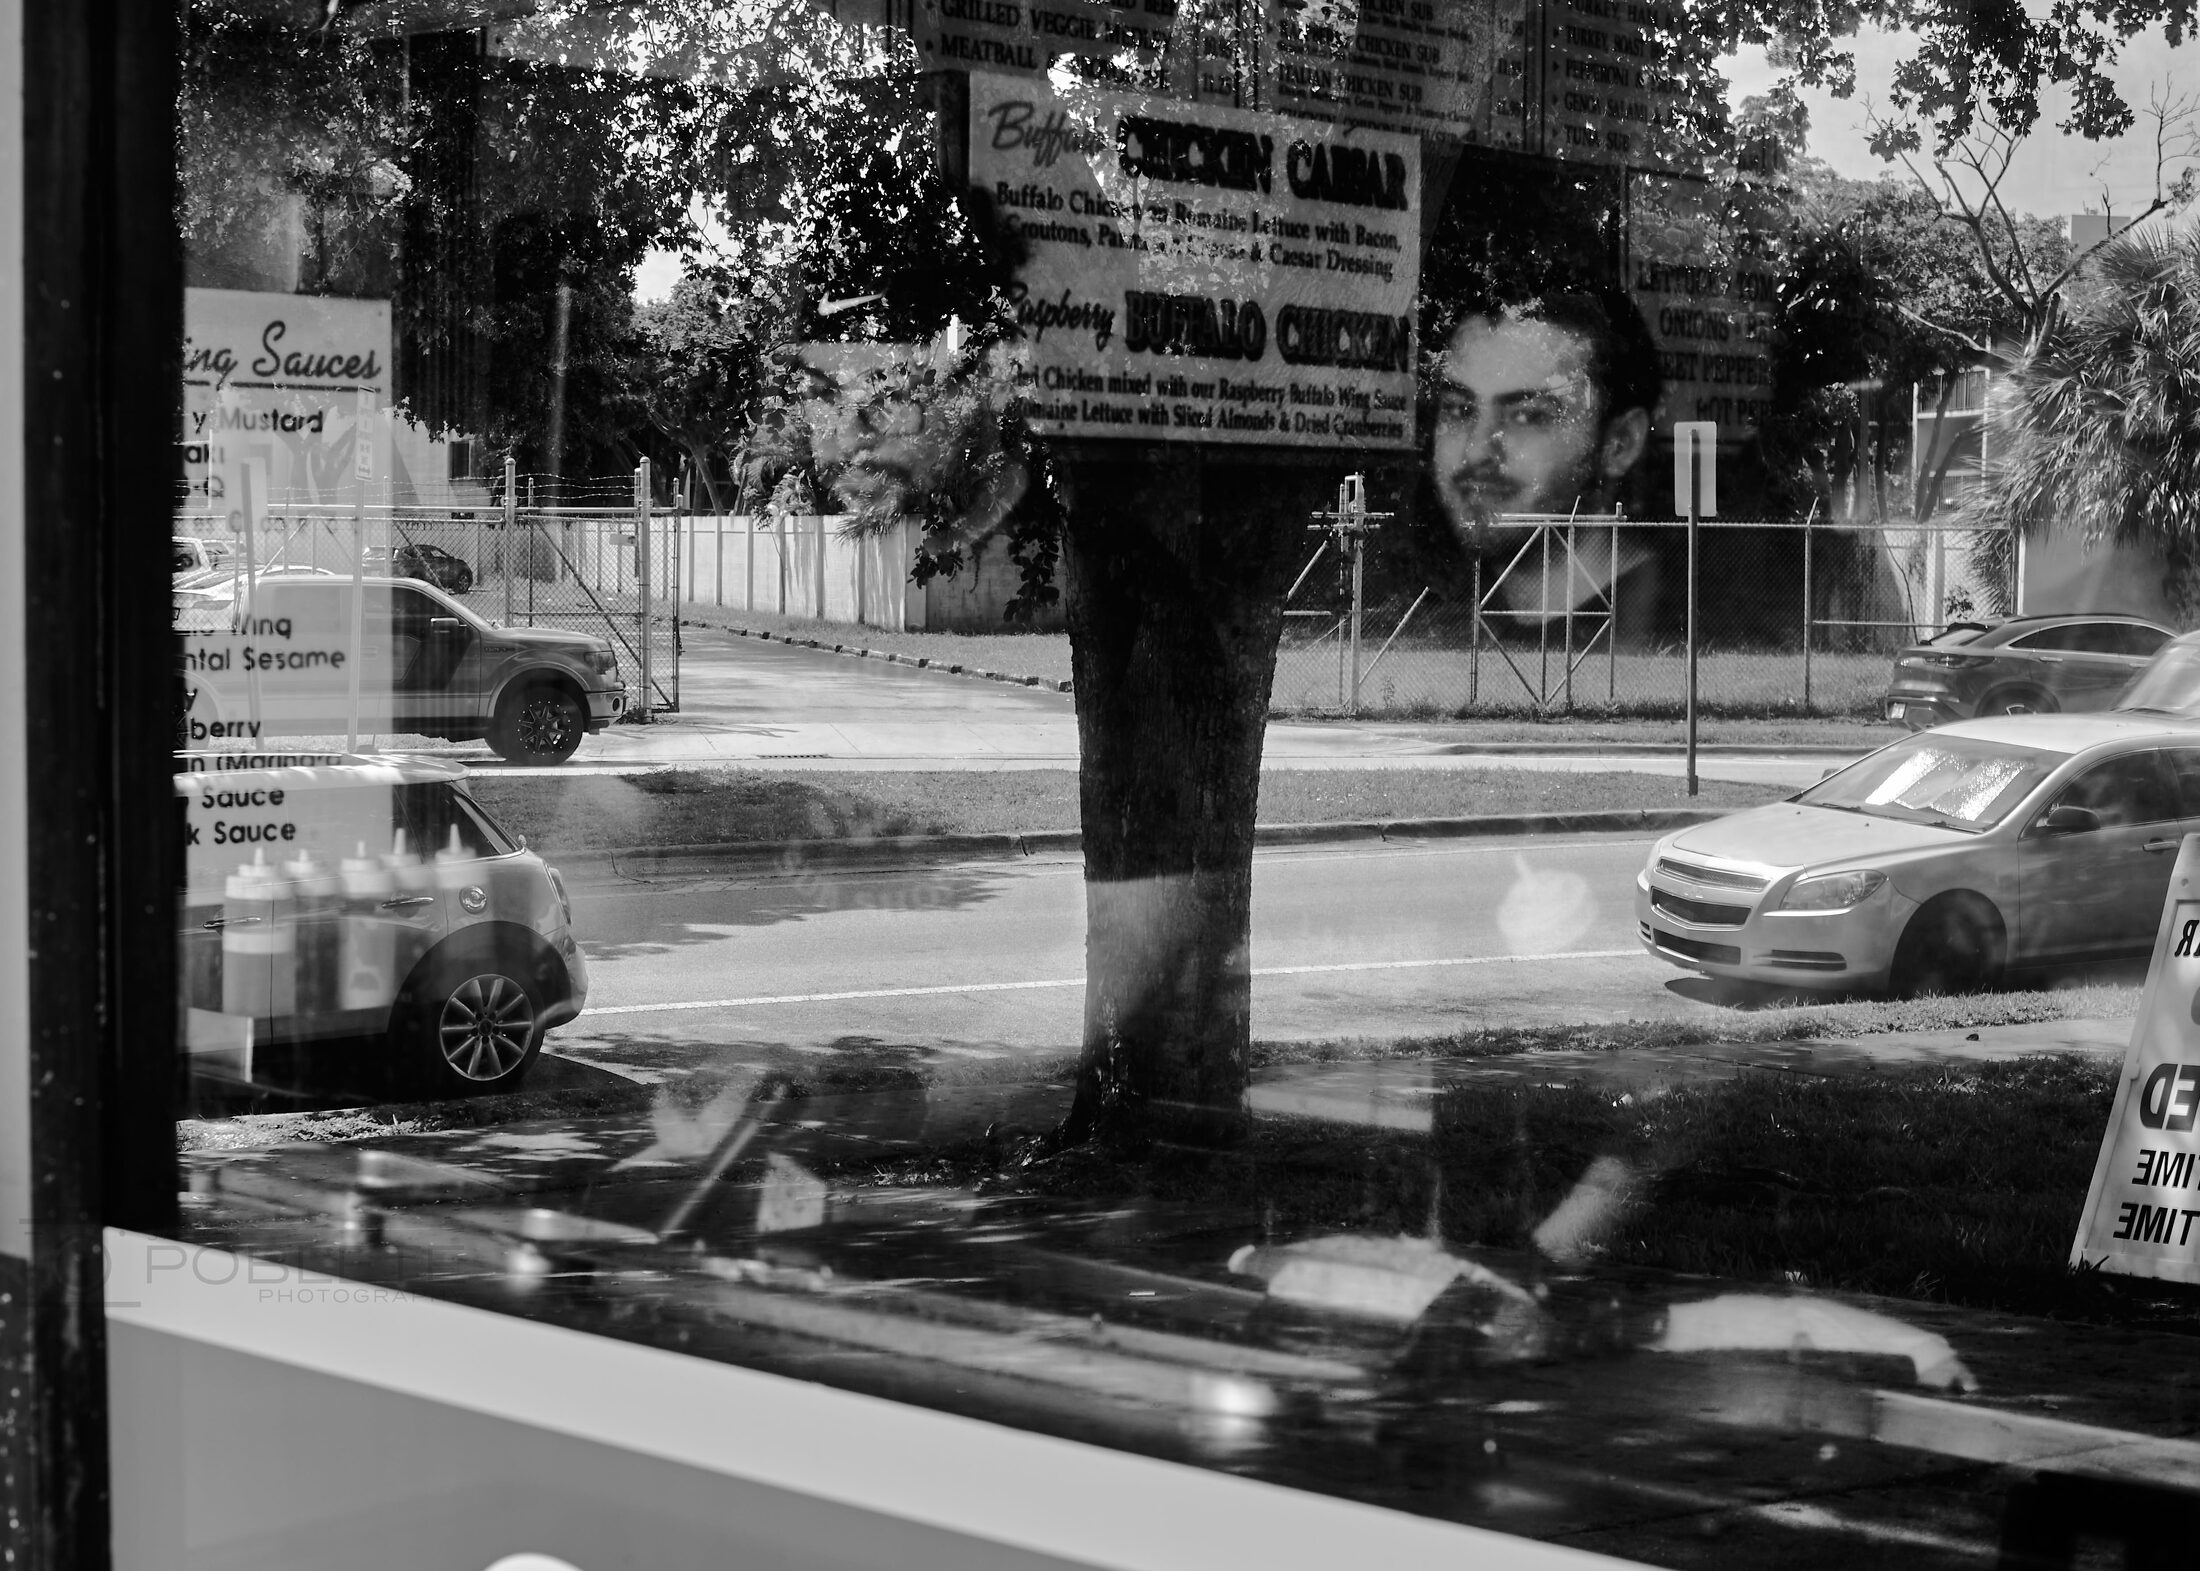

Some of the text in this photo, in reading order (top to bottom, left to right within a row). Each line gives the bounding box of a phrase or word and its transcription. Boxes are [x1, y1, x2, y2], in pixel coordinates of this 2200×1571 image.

[940, 0, 1020, 27] GRILLED
[1029, 8, 1096, 40] VEGGIE
[941, 33, 1037, 69] MEATBALL
[1356, 34, 1410, 60] CHICKEN
[1417, 45, 1440, 64] SUB
[1399, 83, 1422, 103] SUB
[988, 100, 1104, 167] Buffa
[1117, 114, 1273, 194] CHICKEN
[996, 181, 1064, 211] Buffalo
[1069, 190, 1142, 220] Chicn
[1252, 210, 1310, 239] Lettuce
[1315, 221, 1350, 245] with
[1355, 224, 1402, 253] Bacon,
[1270, 243, 1322, 269] Caesar
[1327, 248, 1393, 283] Dressing
[1124, 290, 1267, 362] BUFFALO
[1276, 304, 1411, 373] CHICKEN
[1659, 307, 1730, 341] ONIONS
[253, 320, 381, 380] Sauces
[1043, 365, 1104, 392] Chicken
[1108, 371, 1151, 395] mixed
[1156, 374, 1188, 398] with
[1191, 382, 1216, 399] our
[1219, 377, 1285, 409] Raspberry
[1290, 383, 1335, 406] Buffalo
[219, 406, 323, 432] Mustard
[1082, 398, 1134, 424] Lettuce
[1138, 402, 1170, 426] with
[1173, 404, 1212, 428] Sliced
[1217, 407, 1276, 431] Almonds
[243, 646, 345, 671] Sesame
[202, 786, 285, 808] Sauce
[214, 821, 296, 844] Sauce
